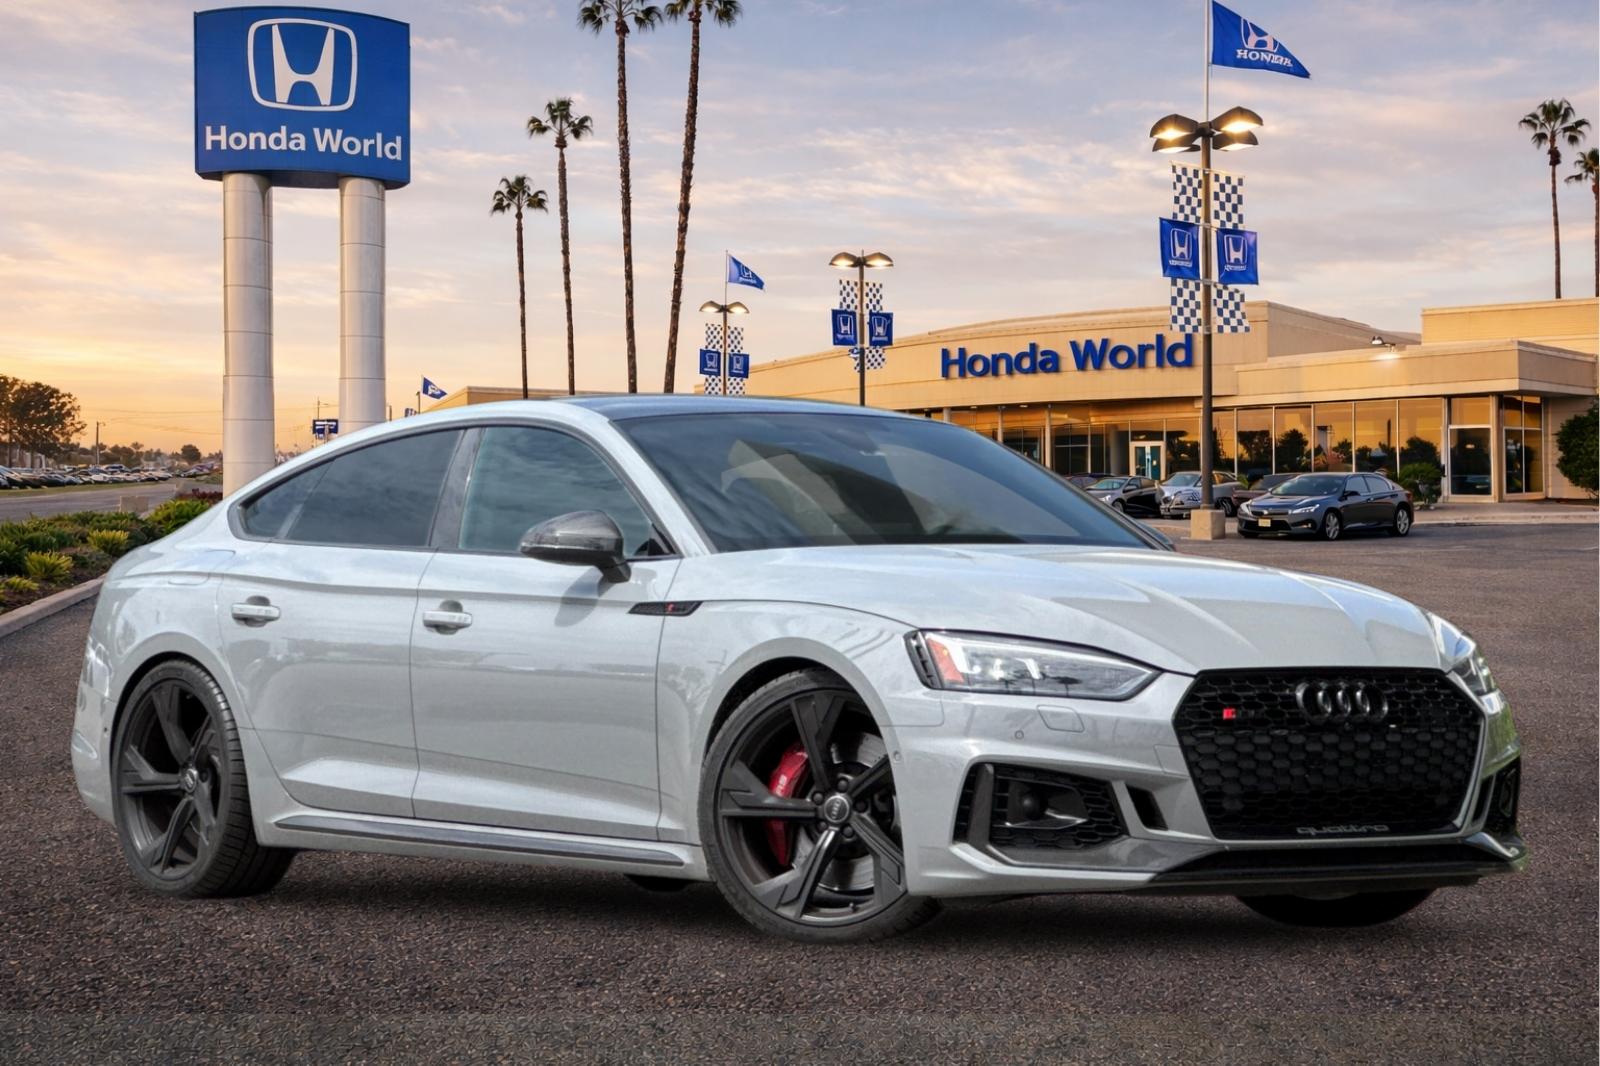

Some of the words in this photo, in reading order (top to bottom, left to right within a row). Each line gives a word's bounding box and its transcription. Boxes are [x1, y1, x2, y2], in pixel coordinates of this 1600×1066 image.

[205, 125, 306, 151] Honda
[313, 127, 402, 160] World
[941, 342, 1060, 379] Honda
[1069, 333, 1194, 371] World
[1296, 824, 1390, 836] quattro
